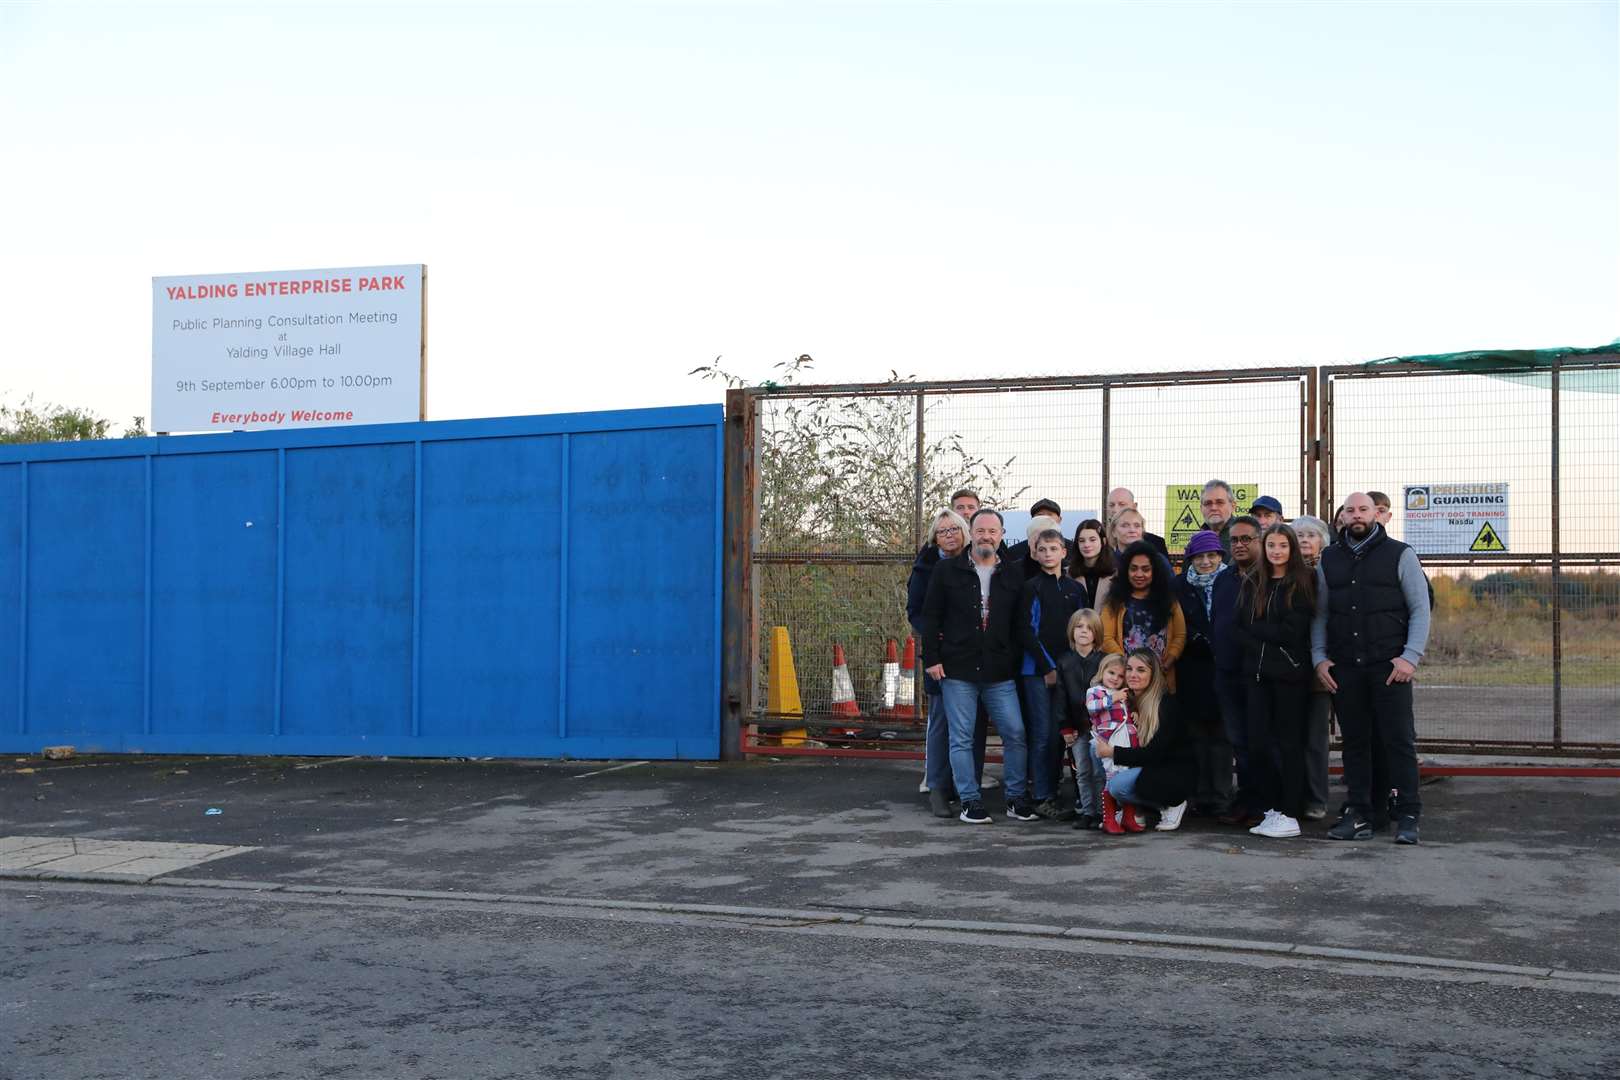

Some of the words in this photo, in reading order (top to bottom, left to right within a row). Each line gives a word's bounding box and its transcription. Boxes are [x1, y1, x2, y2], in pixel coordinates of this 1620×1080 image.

[167, 284, 238, 299] YALDING
[245, 278, 351, 296] ENTERPRISE
[359, 275, 404, 291] PARK
[173, 319, 207, 330] Public
[213, 318, 262, 329] Planning
[268, 314, 342, 327] Consultation
[349, 312, 397, 324] Meeting
[278, 333, 287, 341] at
[227, 347, 268, 359] Yalding
[274, 345, 313, 358] Village
[320, 344, 340, 355] Hall
[177, 381, 195, 392] 9th
[201, 379, 265, 392] September
[271, 377, 316, 390] 6.00pm
[323, 377, 334, 387] to
[341, 375, 392, 388] 10.00pm
[212, 409, 285, 424] Everybody
[291, 410, 353, 421] Welcome
[1433, 496, 1504, 504] GUARDING
